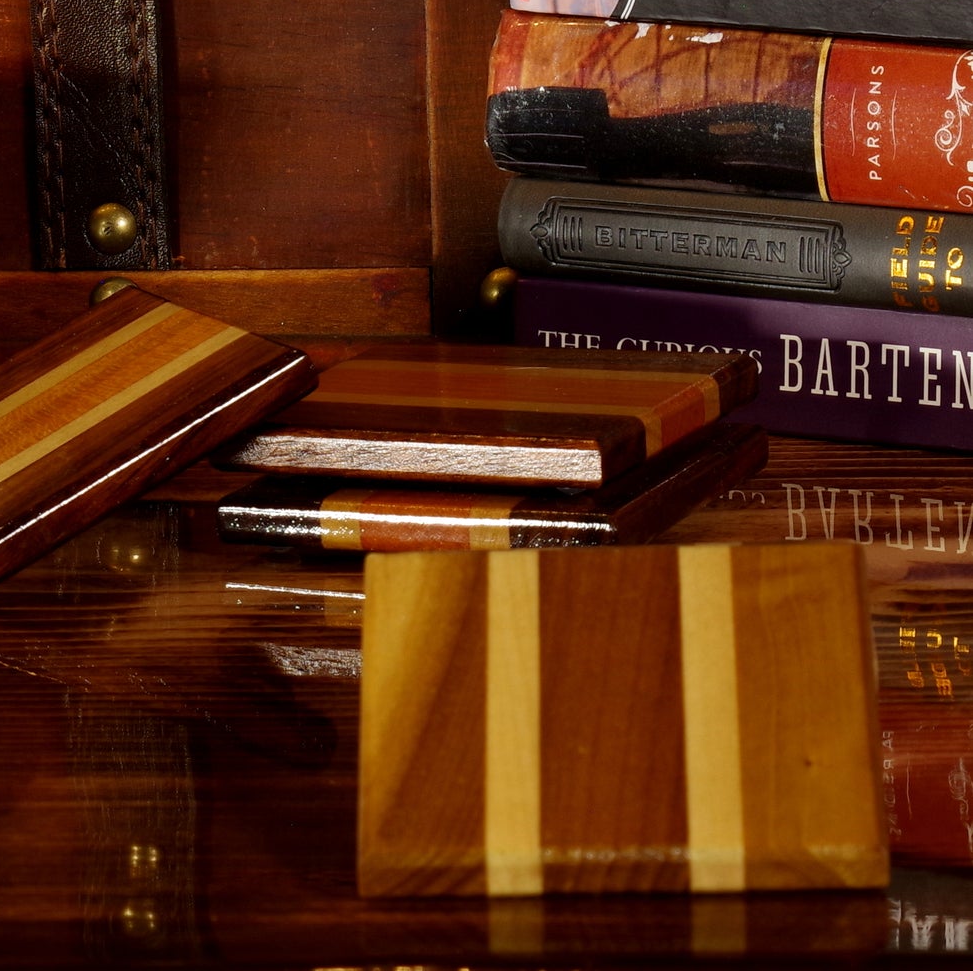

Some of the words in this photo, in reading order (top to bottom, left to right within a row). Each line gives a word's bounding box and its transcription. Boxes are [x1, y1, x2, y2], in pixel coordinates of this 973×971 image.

[867, 65, 885, 181] PARSONS
[595, 225, 787, 264] BITTERMAN
[890, 215, 915, 307] FIELD
[918, 215, 945, 312] GUIDE
[945, 247, 964, 291] TO
[779, 334, 973, 410] BARTEN
